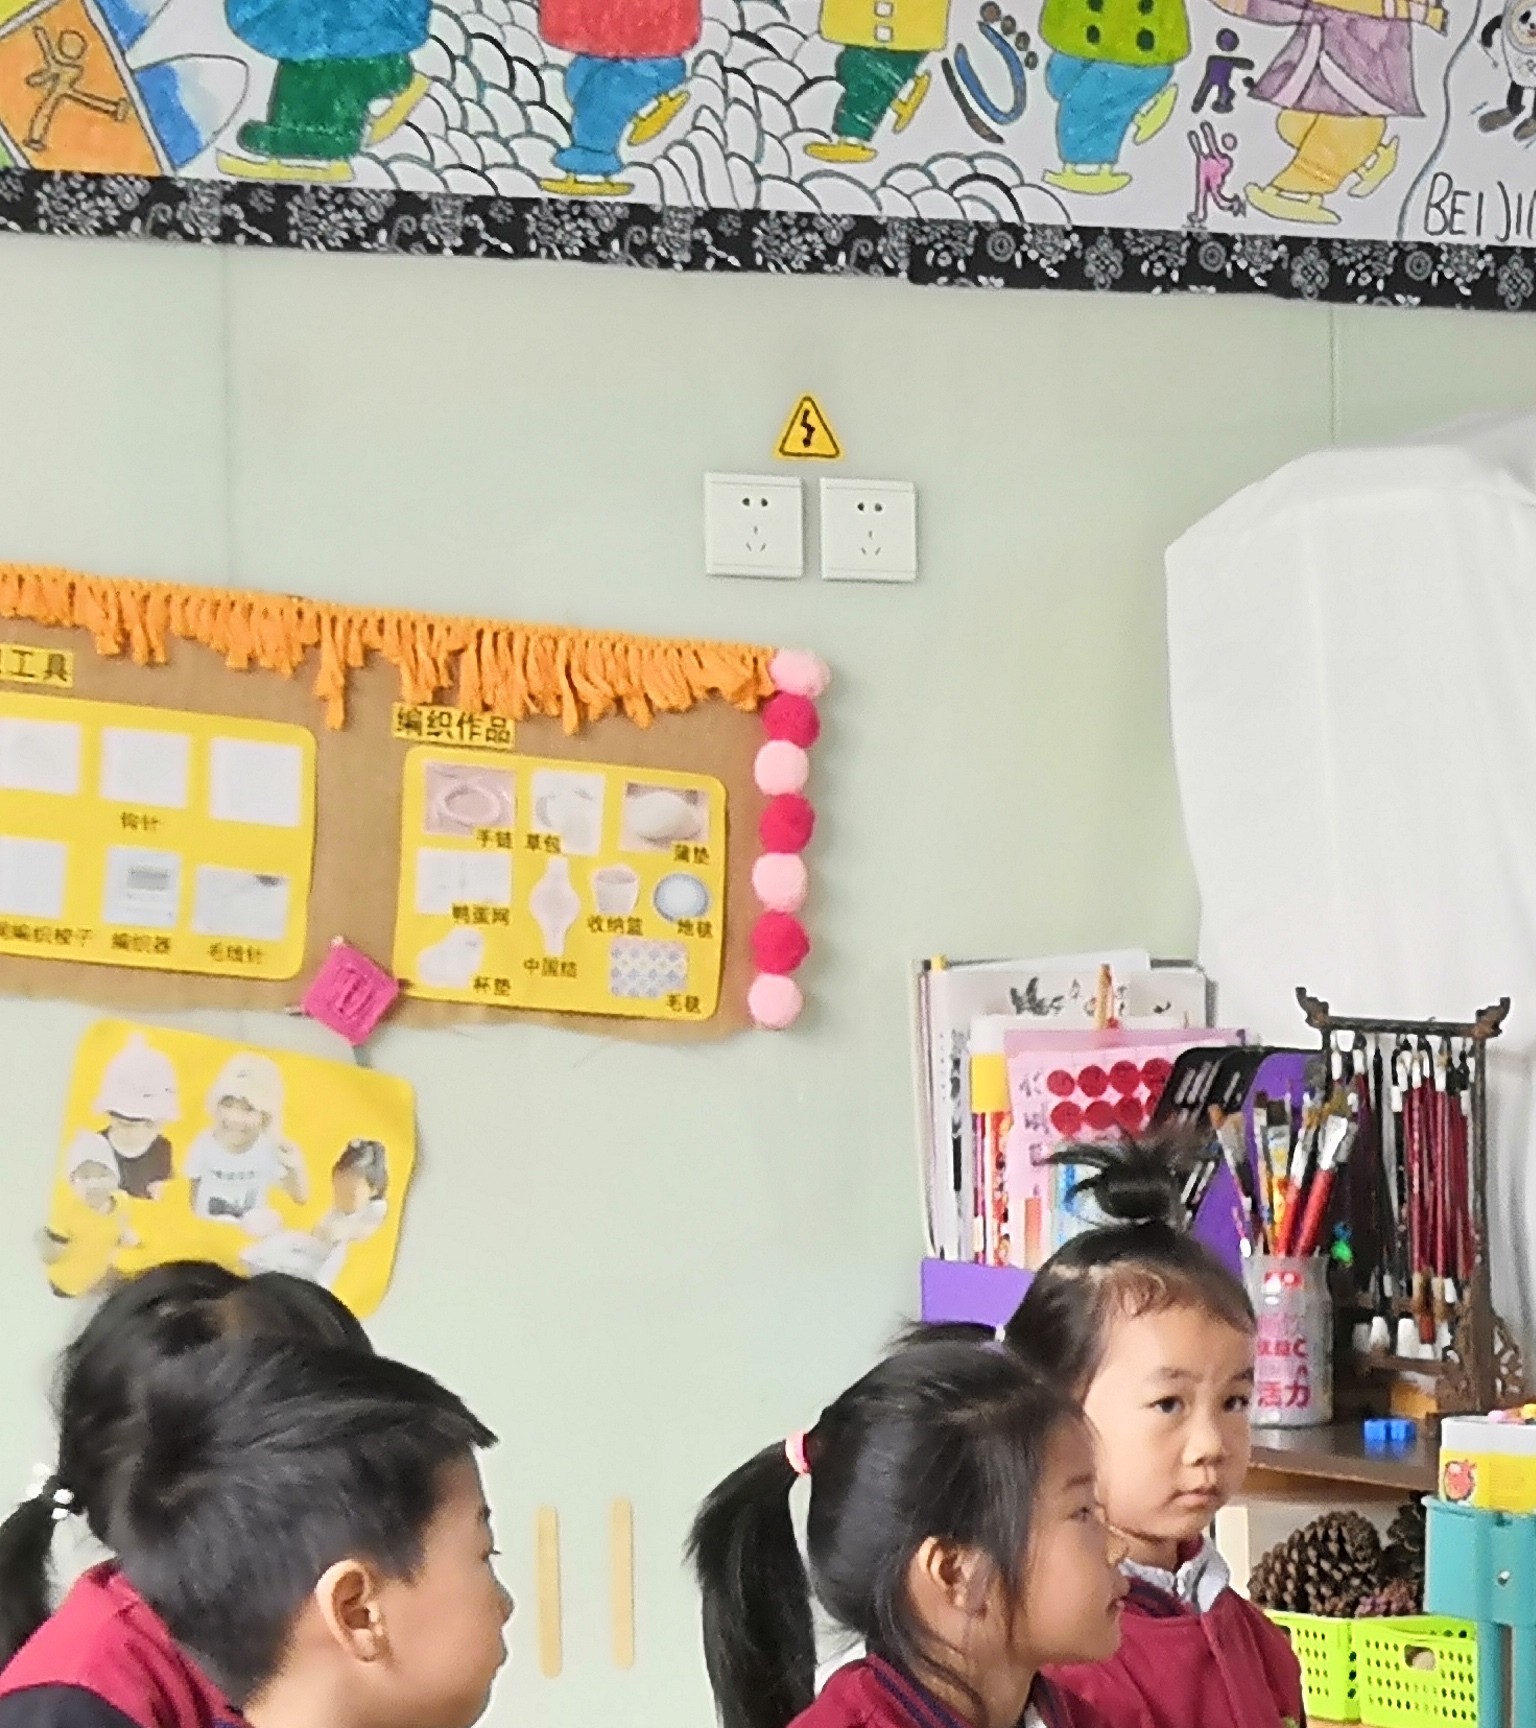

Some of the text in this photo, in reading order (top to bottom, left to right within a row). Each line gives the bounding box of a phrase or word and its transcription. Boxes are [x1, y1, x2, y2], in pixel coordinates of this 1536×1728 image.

[0, 648, 68, 682] 工具
[396, 708, 511, 745] 编织作品
[524, 833, 562, 855] 草包
